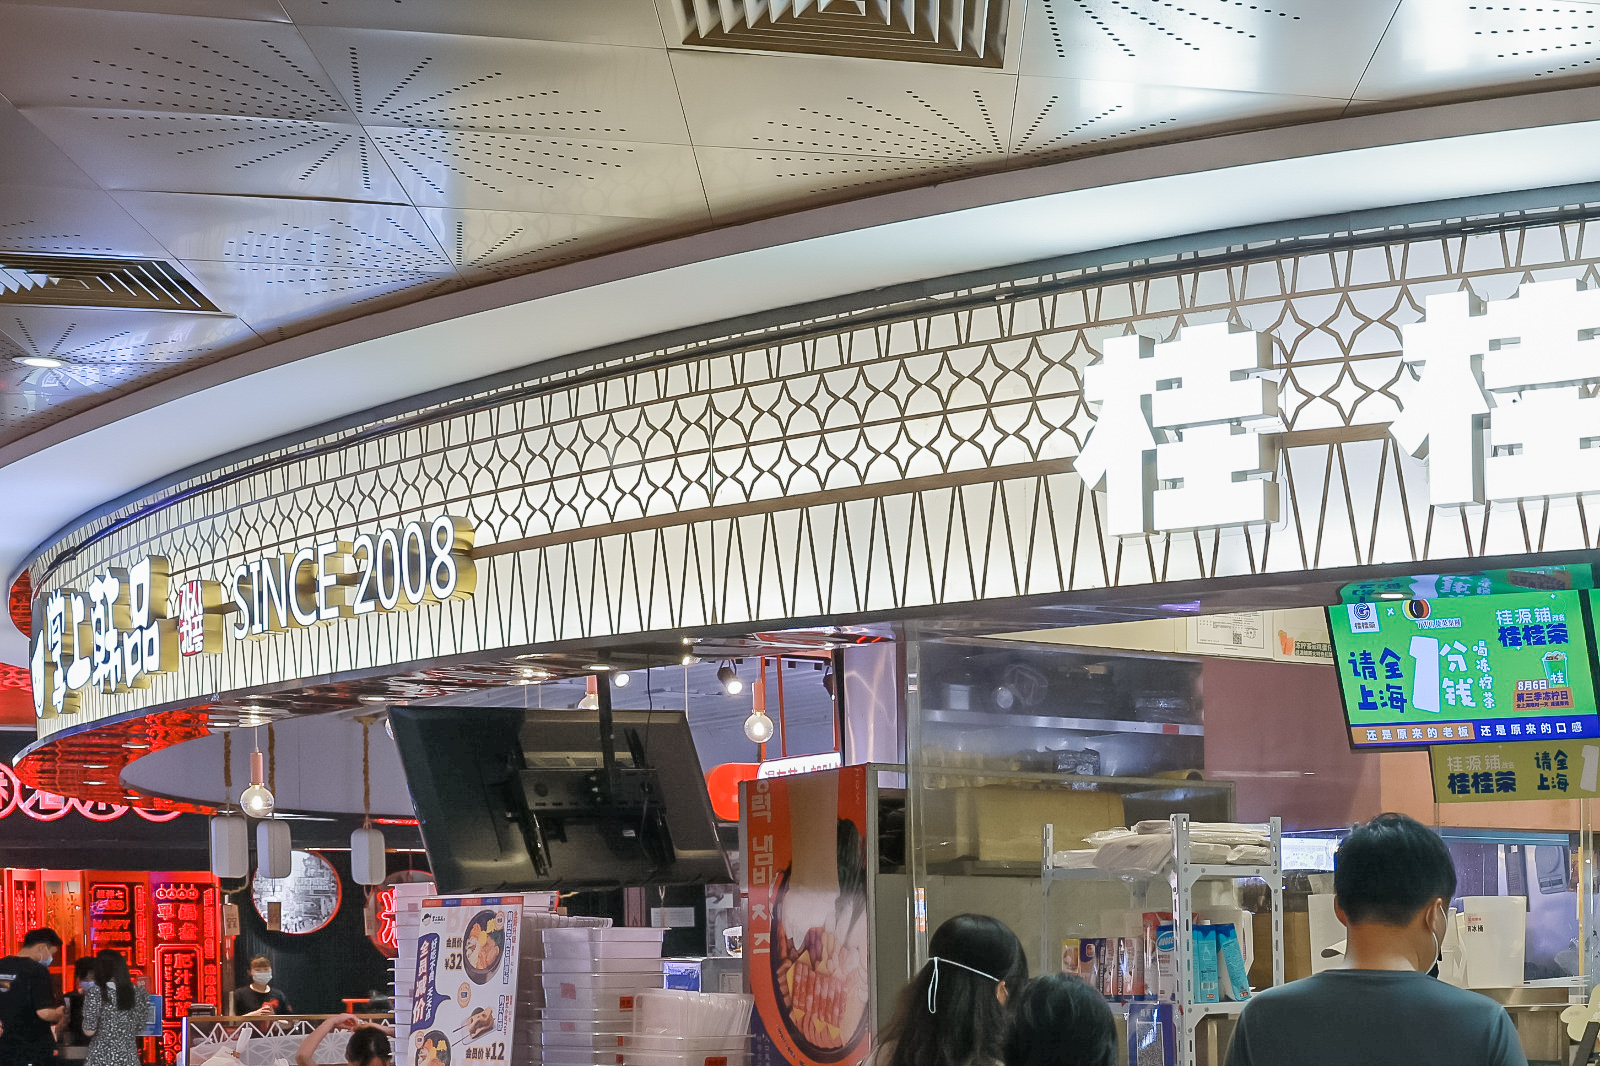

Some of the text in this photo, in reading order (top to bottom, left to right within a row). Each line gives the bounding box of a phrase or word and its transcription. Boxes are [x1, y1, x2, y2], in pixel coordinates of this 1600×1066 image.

[233, 515, 458, 640] SINCE 2008
[1498, 623, 1569, 647] 桂桂茶
[1348, 647, 1404, 680] 请全
[1409, 635, 1439, 713] 1
[1473, 641, 1496, 708] 喝冻柠茶
[1518, 680, 1548, 690] 8月6日
[1551, 672, 1564, 684] 桂
[1358, 684, 1407, 713] 上海
[1516, 691, 1569, 703] 第三季冻柠日
[1366, 726, 1470, 741] 还是原来的老板
[1480, 721, 1582, 737] 还是原来的口感
[1534, 749, 1568, 771] 请全
[1580, 744, 1599, 792] 1
[1447, 771, 1517, 795] 桂桂茶
[1537, 772, 1569, 792] 上海
[445, 953, 463, 970] ¥32
[485, 1043, 504, 1060] ¥12
